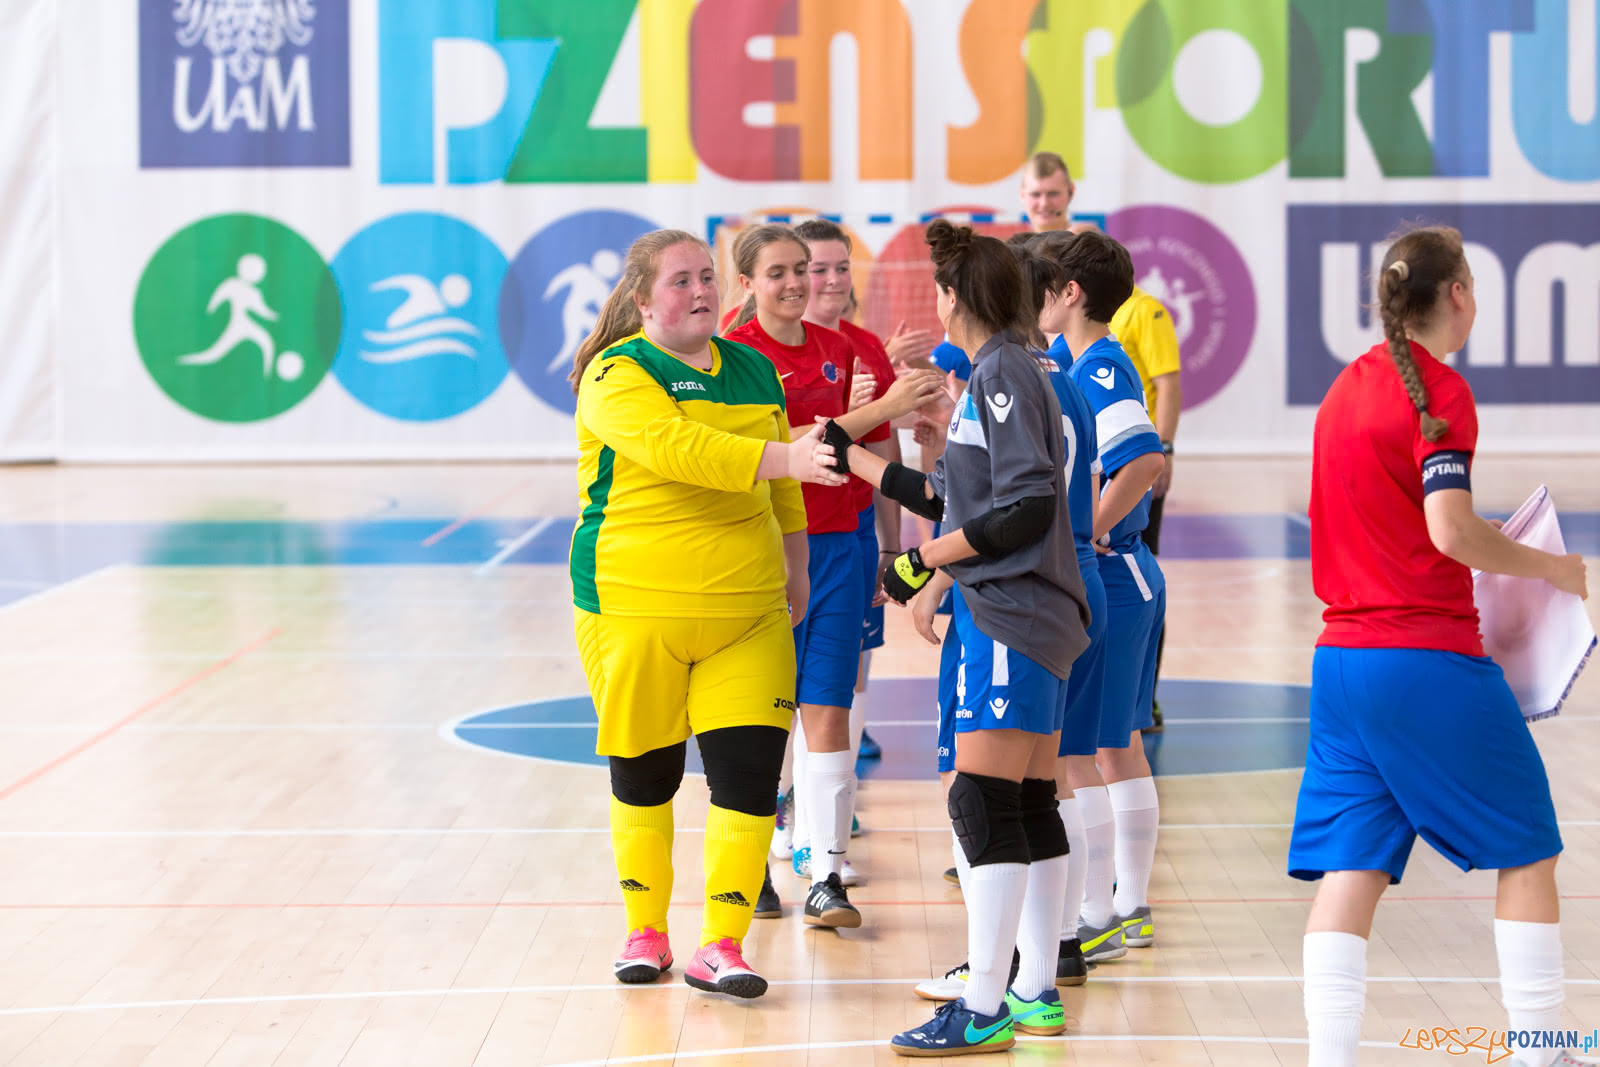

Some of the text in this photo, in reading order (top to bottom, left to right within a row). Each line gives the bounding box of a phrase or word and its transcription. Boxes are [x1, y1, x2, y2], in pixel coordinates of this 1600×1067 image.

[174, 56, 314, 133] UAM
[1422, 463, 1465, 485] APTAIN
[711, 895, 750, 907] adidas
